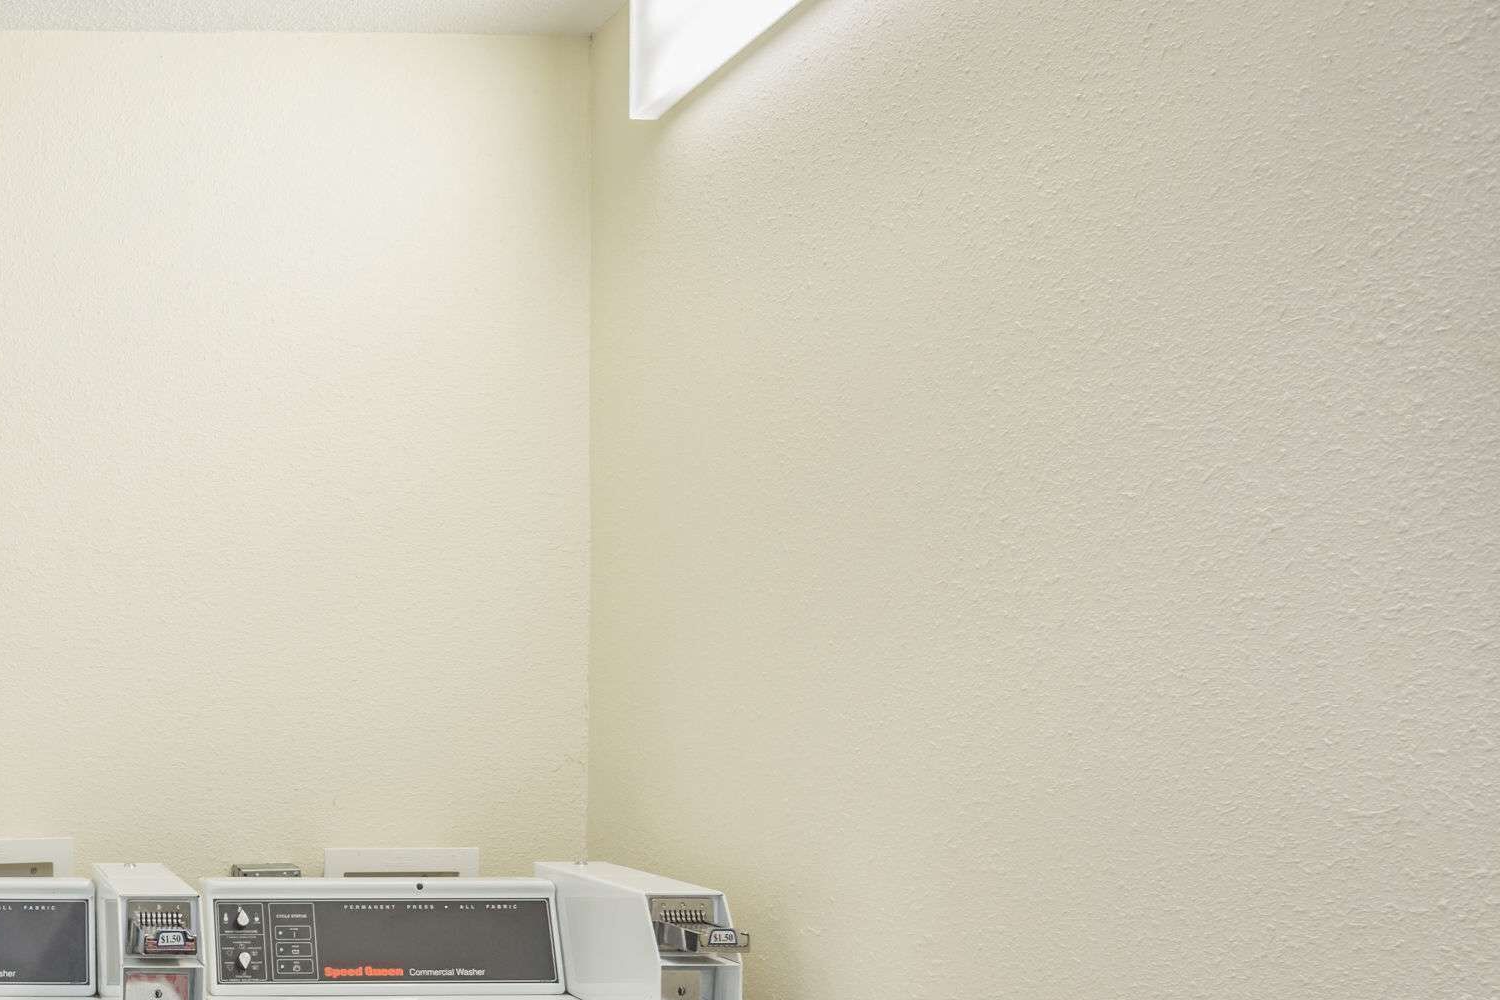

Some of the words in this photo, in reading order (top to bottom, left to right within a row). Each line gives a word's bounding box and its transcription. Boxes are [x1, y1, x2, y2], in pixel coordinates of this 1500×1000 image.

[161, 934, 181, 944] $1.50
[713, 933, 734, 943] $1.50
[323, 966, 363, 978] Speed
[364, 966, 404, 977] Queen
[409, 967, 455, 977] Commercial
[455, 967, 486, 977] Washer
